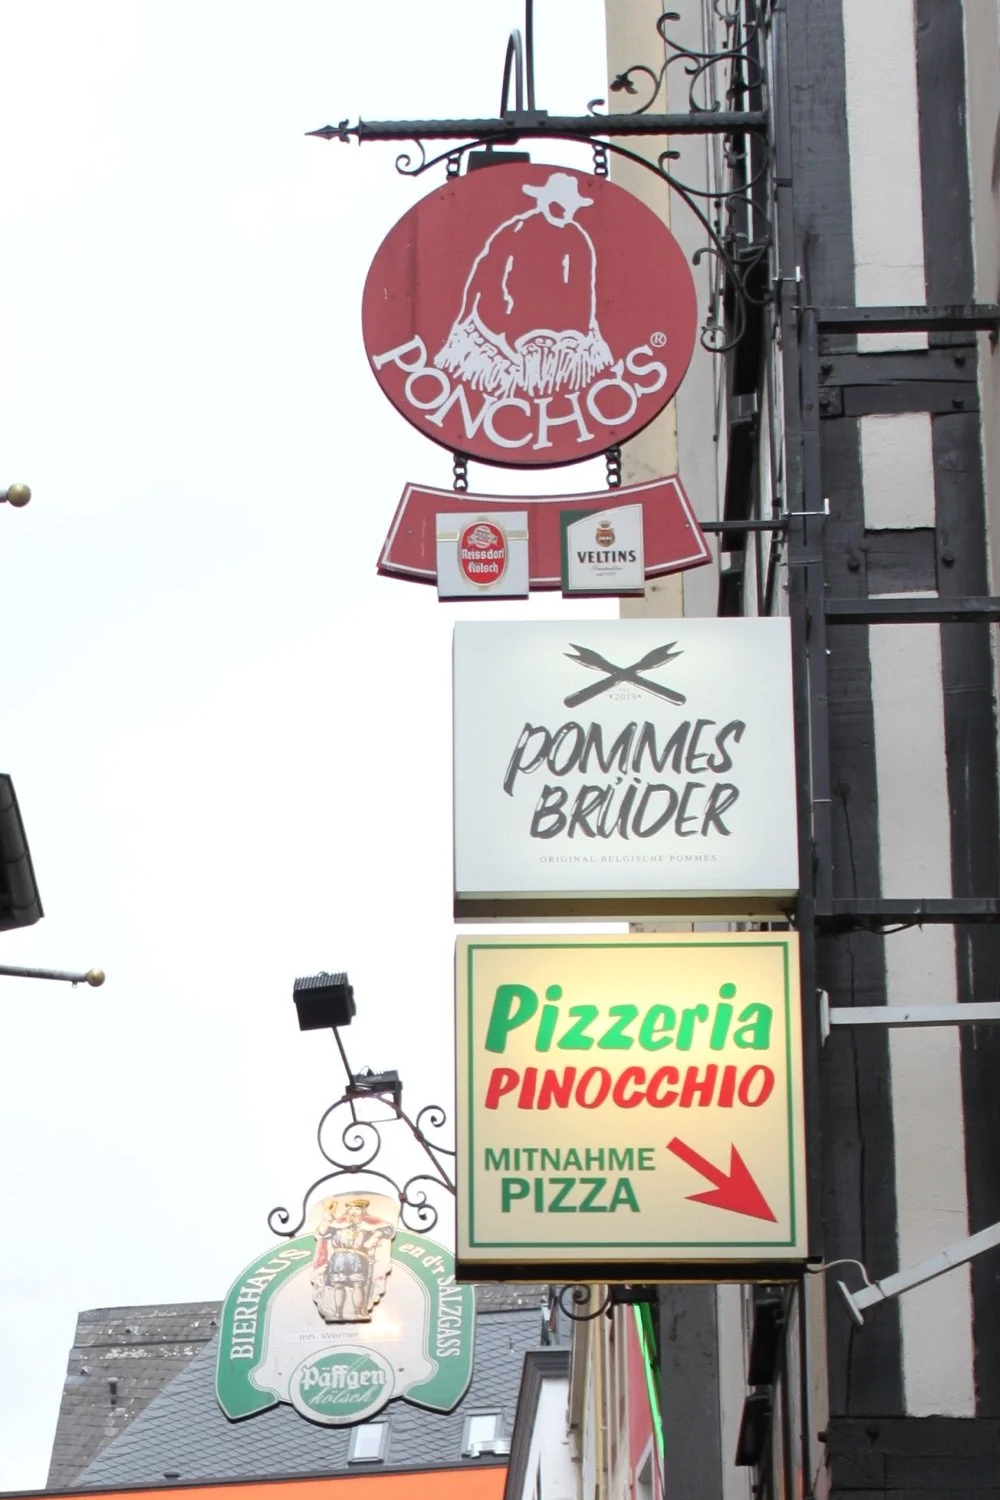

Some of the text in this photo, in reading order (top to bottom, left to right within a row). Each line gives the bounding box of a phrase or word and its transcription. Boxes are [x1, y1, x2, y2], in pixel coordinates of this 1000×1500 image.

[373, 335, 668, 449] PONCHO'S
[461, 548, 505, 560] Reissdorf
[468, 561, 498, 575] Kölsch
[577, 549, 637, 564] VELTINS
[503, 718, 746, 797] POMMES
[530, 775, 741, 841] BRÜDER
[540, 854, 718, 863] ORIGINAL BELGISCHE POMMES
[485, 983, 774, 1055] Pizzeria
[485, 1063, 776, 1111] PINOCCHIO
[485, 1147, 656, 1172] MITNAHME
[501, 1177, 641, 1214] PIZZA
[230, 1248, 312, 1360] BIERHAUS
[399, 1241, 425, 1259] en
[436, 1273, 464, 1358] SALZGASS
[301, 1364, 388, 1391] Päffgen
